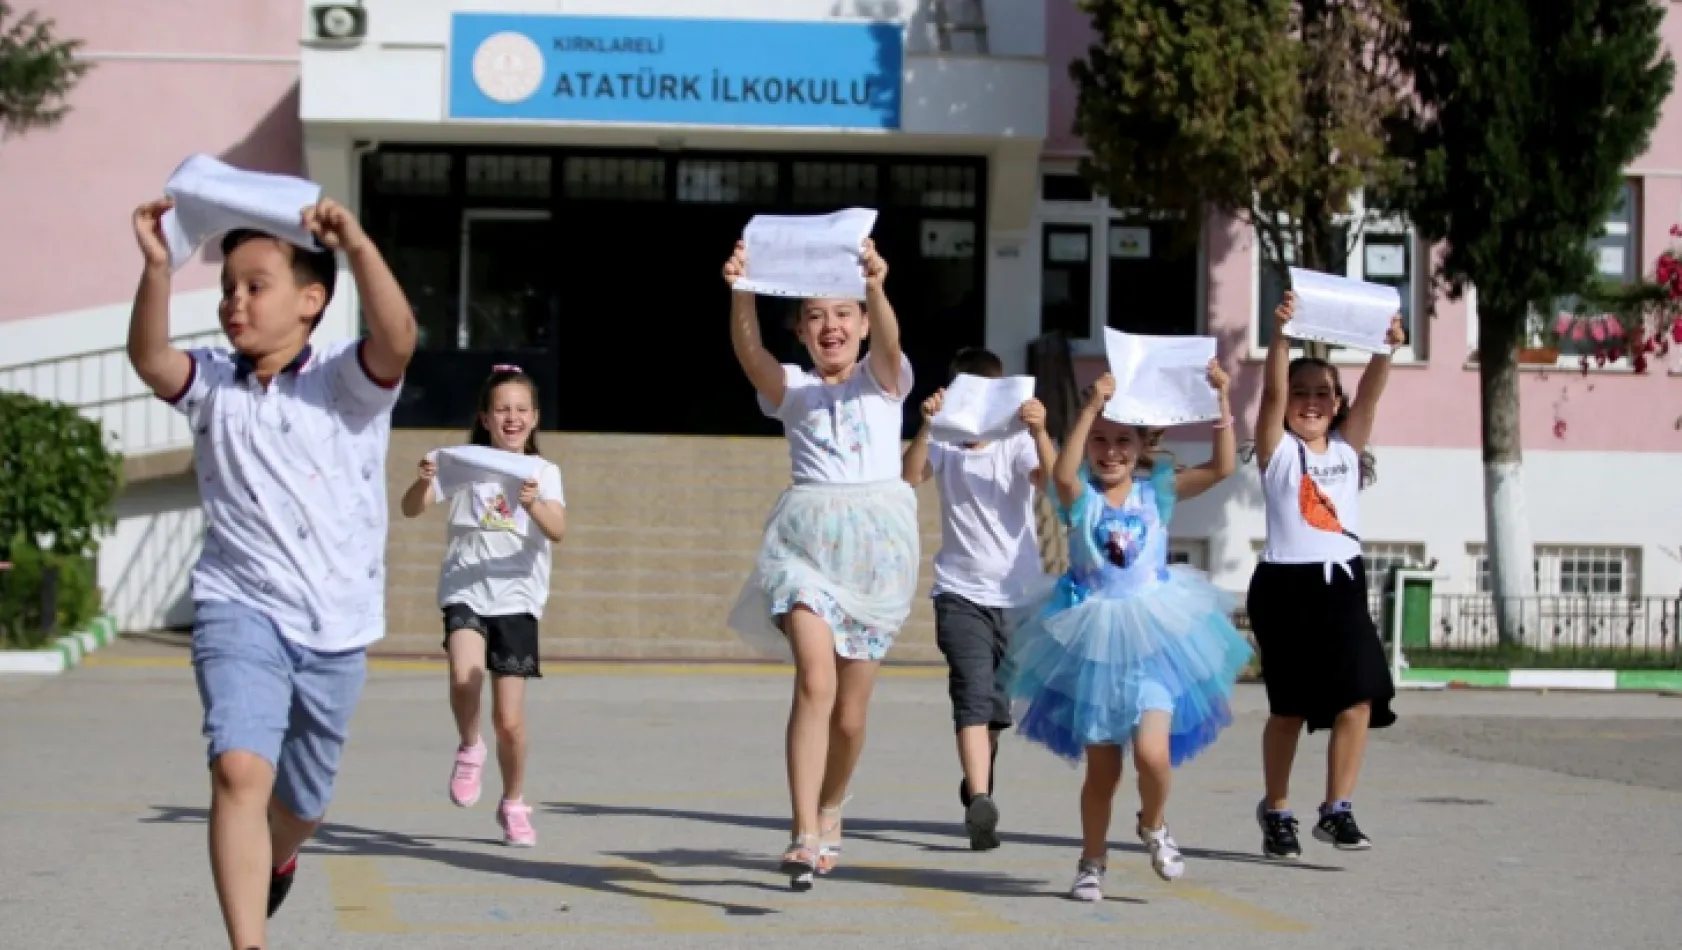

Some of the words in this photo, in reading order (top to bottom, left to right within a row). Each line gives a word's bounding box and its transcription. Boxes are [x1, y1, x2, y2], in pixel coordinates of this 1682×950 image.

[553, 34, 664, 53] KIRKLARELİ
[553, 66, 702, 101] ATATÜRK
[711, 68, 870, 104] İLKOKULU
